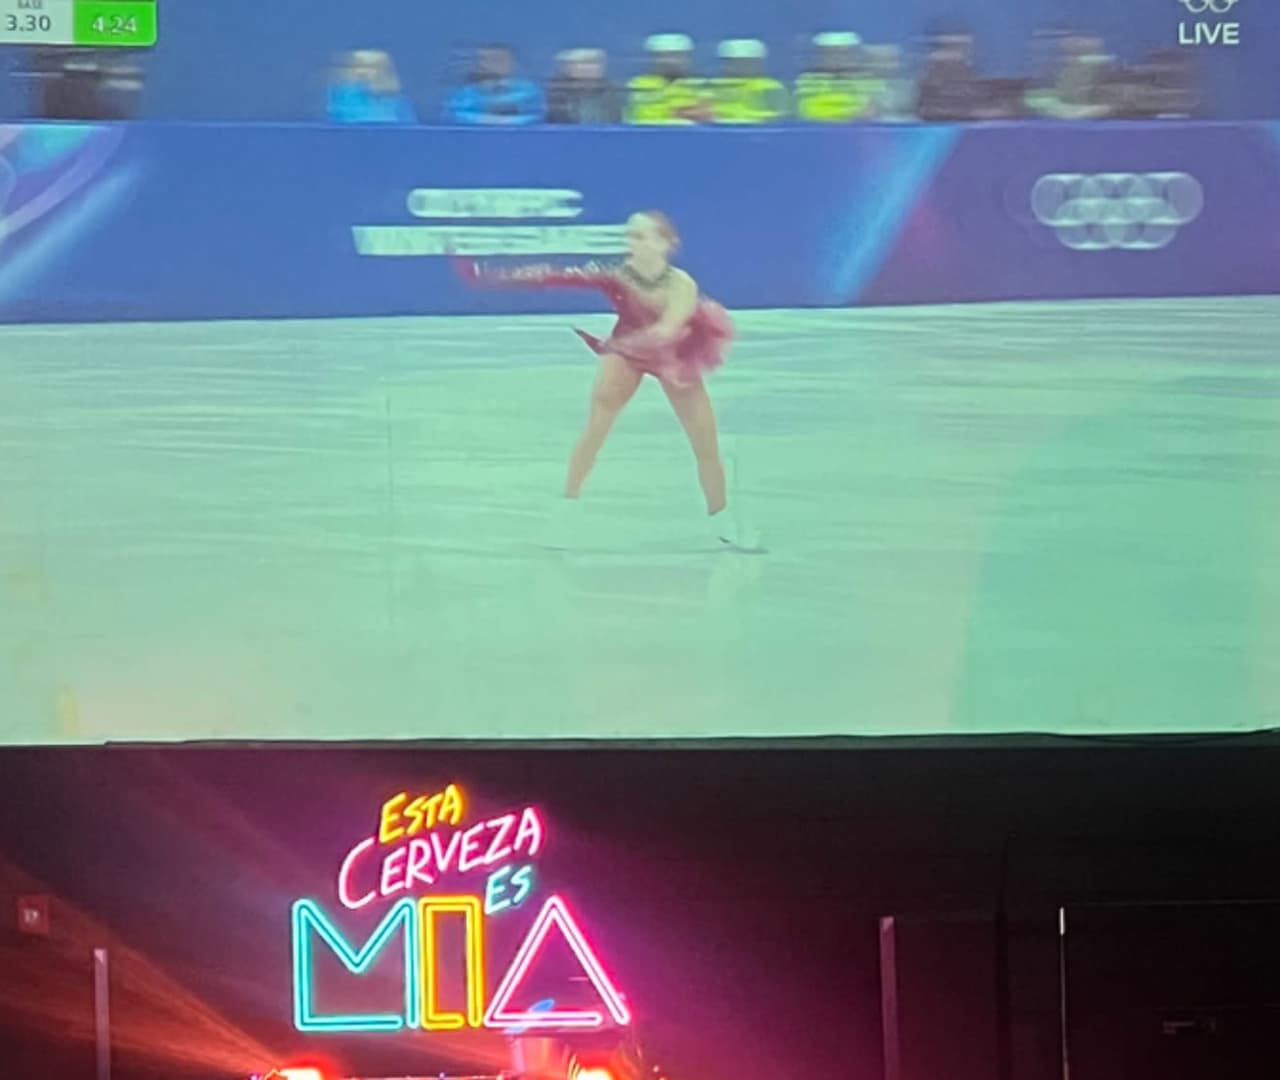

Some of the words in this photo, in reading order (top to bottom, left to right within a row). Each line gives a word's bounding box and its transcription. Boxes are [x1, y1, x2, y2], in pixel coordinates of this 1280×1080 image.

[5, 14, 51, 32] 3.30
[91, 15, 137, 34] 4.24
[1178, 22, 1240, 45] LIVE
[379, 783, 464, 844] ESTA
[338, 807, 545, 909] CERVEZA
[485, 864, 534, 914] ES
[290, 893, 631, 1032] MIA
